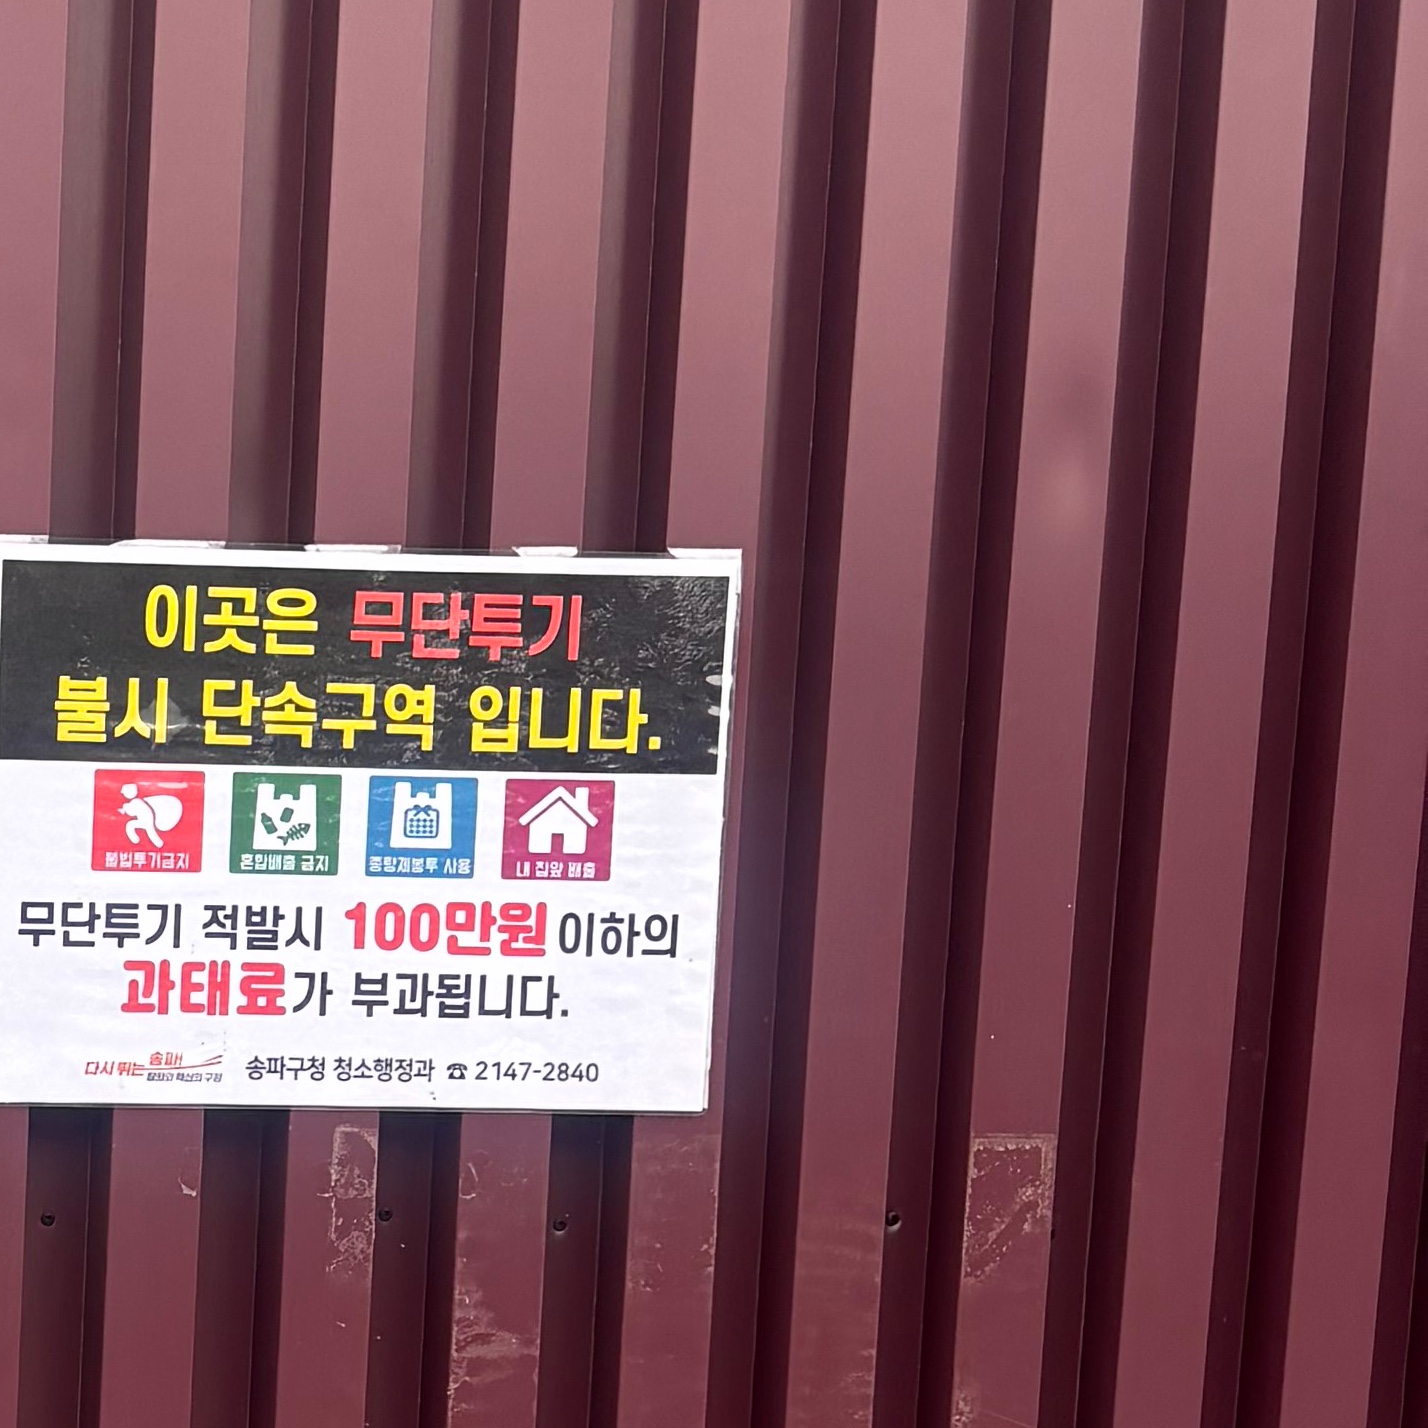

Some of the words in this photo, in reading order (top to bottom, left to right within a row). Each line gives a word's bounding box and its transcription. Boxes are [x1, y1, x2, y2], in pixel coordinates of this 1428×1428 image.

[145, 583, 318, 656] 이곳은
[350, 588, 582, 662] 무단투기
[55, 676, 167, 744] 불시
[202, 678, 435, 752] 단속구역
[470, 683, 662, 754] 입니다.
[105, 852, 189, 870] 불법투기금지
[240, 854, 296, 871] 혼합배출
[301, 855, 328, 871] 금지
[369, 856, 438, 873] 종량제봉투
[444, 859, 470, 874] 사용
[516, 861, 529, 877] 내
[535, 862, 563, 878] 집앞
[569, 862, 595, 878] 배출
[18, 901, 182, 951] 무단투기
[202, 903, 323, 951] 적발시
[344, 901, 548, 958] 100만원
[560, 911, 678, 959] 이하의
[121, 960, 332, 1017] 과태료가
[352, 972, 569, 1019] 부과됩니다.
[85, 1061, 114, 1075] 다시
[117, 1062, 144, 1076] 뛰는
[246, 1056, 326, 1081] 송파구청
[333, 1056, 435, 1082] 청소행정과
[474, 1061, 599, 1083] 2147-2840
